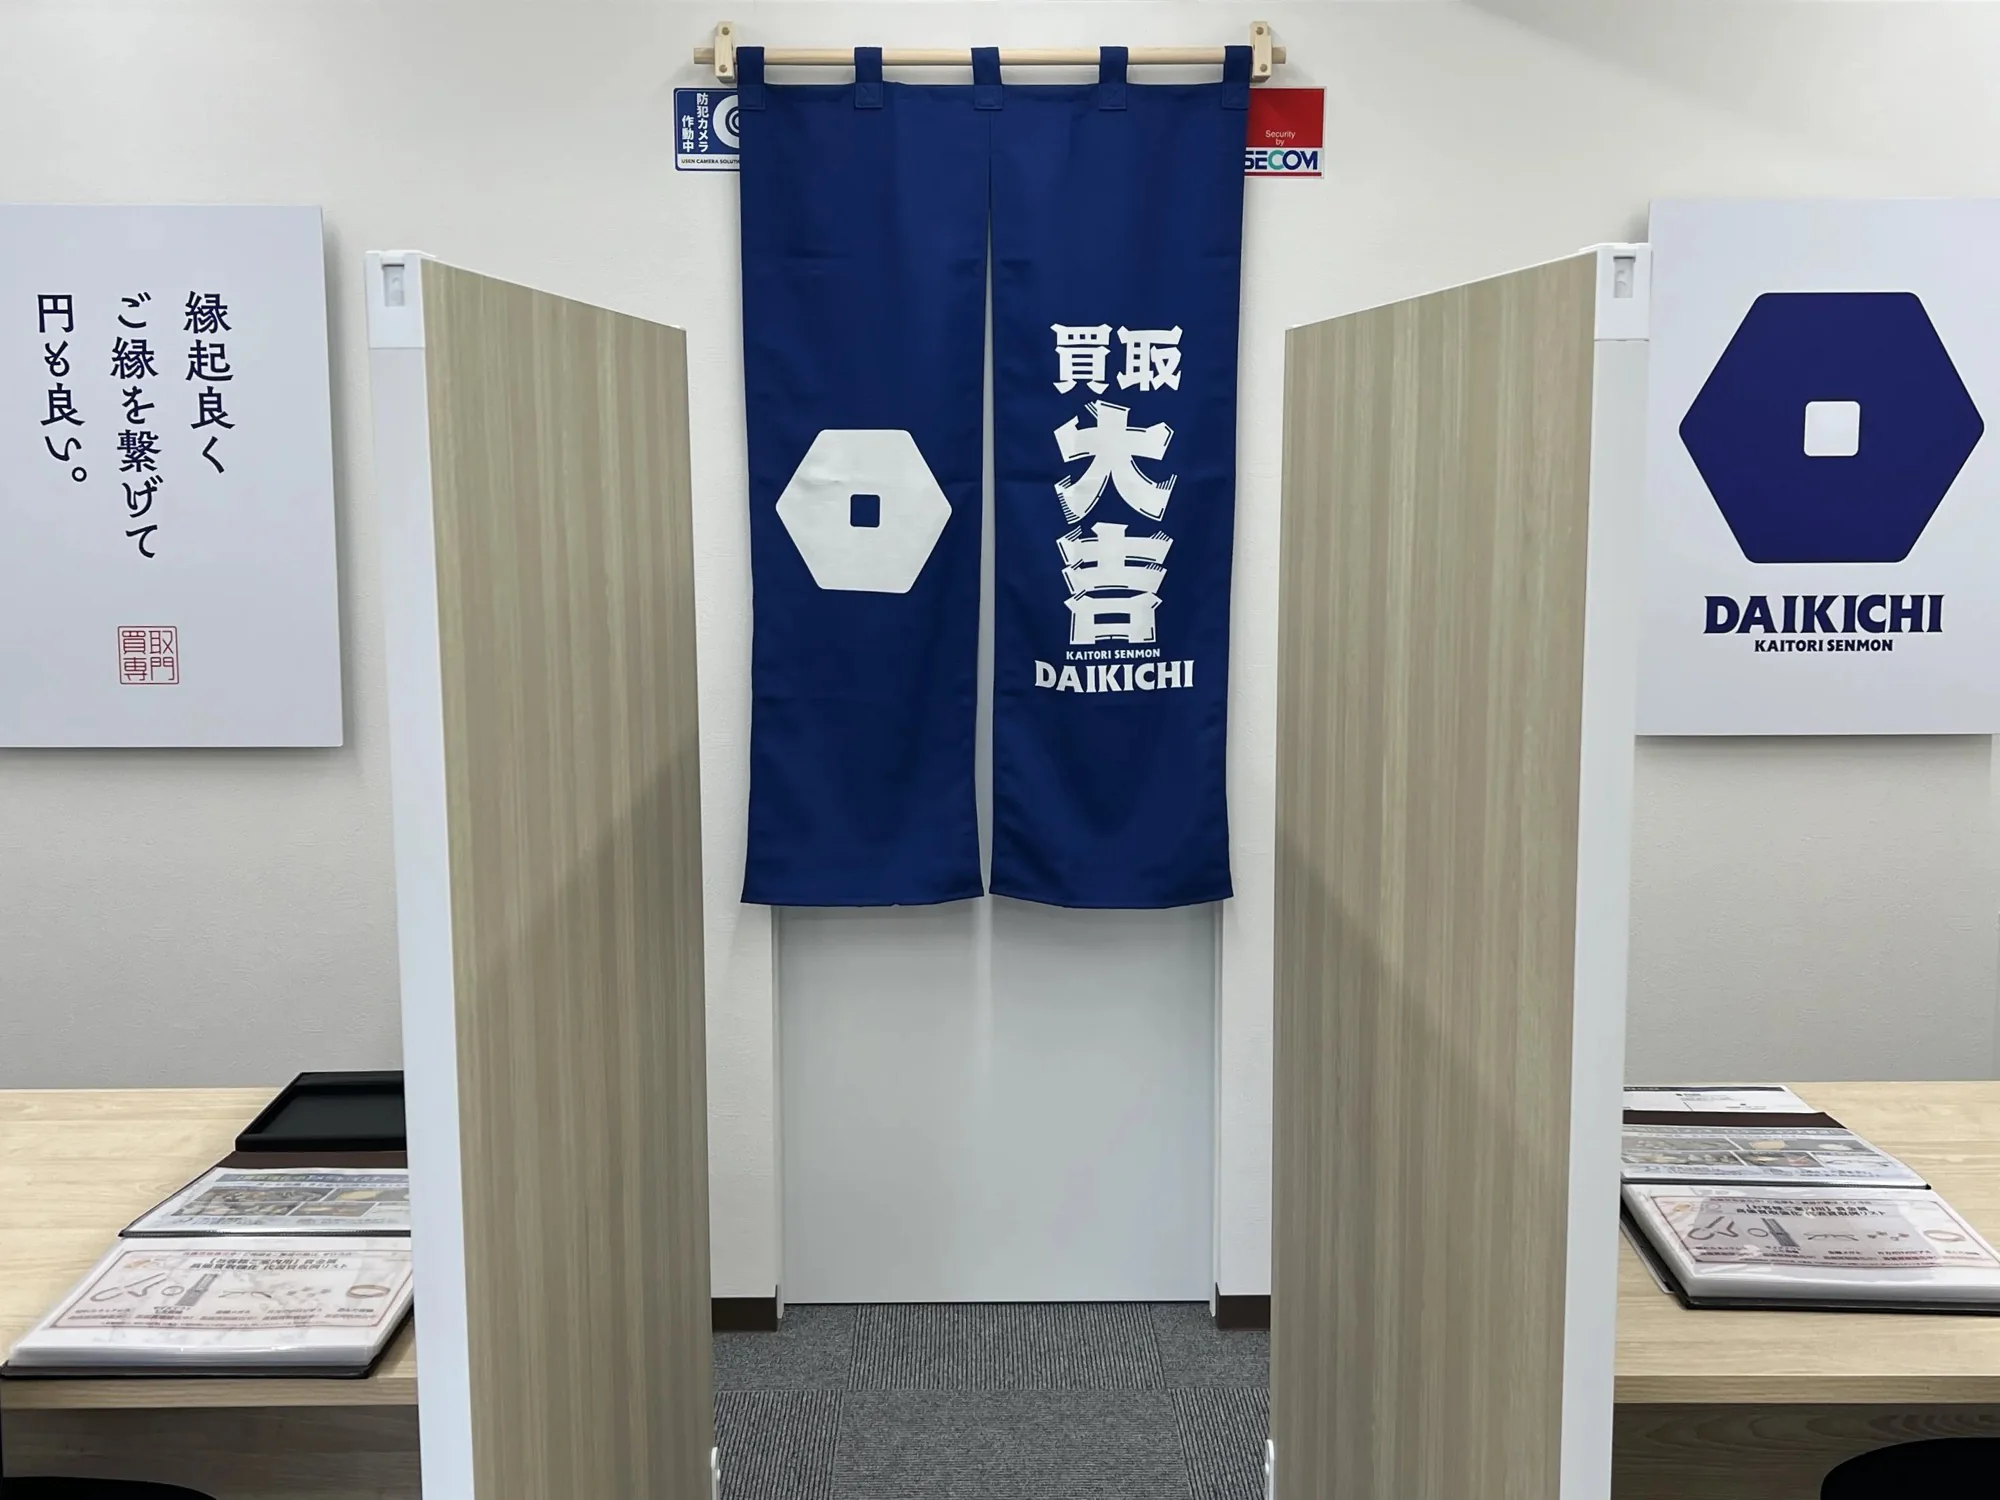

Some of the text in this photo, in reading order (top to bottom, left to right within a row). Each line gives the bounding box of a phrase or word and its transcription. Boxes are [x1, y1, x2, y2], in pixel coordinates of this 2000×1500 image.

[681, 115, 694, 153] 作動中
[696, 92, 709, 152] 防犯カメラ
[1265, 129, 1296, 139] Security
[1244, 149, 1318, 170] SECOM
[1275, 138, 1285, 147] by
[1050, 323, 1183, 395] 買取
[37, 293, 88, 483] 円も良い。
[183, 290, 236, 474] 縁起良く
[110, 291, 163, 559] ご縁を繋げて
[1053, 399, 1178, 646] 大吉
[1703, 593, 1945, 634] DAIKICHI
[1066, 648, 1160, 661] KAITORI SENMON
[1754, 639, 1894, 652] KAITORI SENMON
[1034, 659, 1195, 694] DAIKICHI
